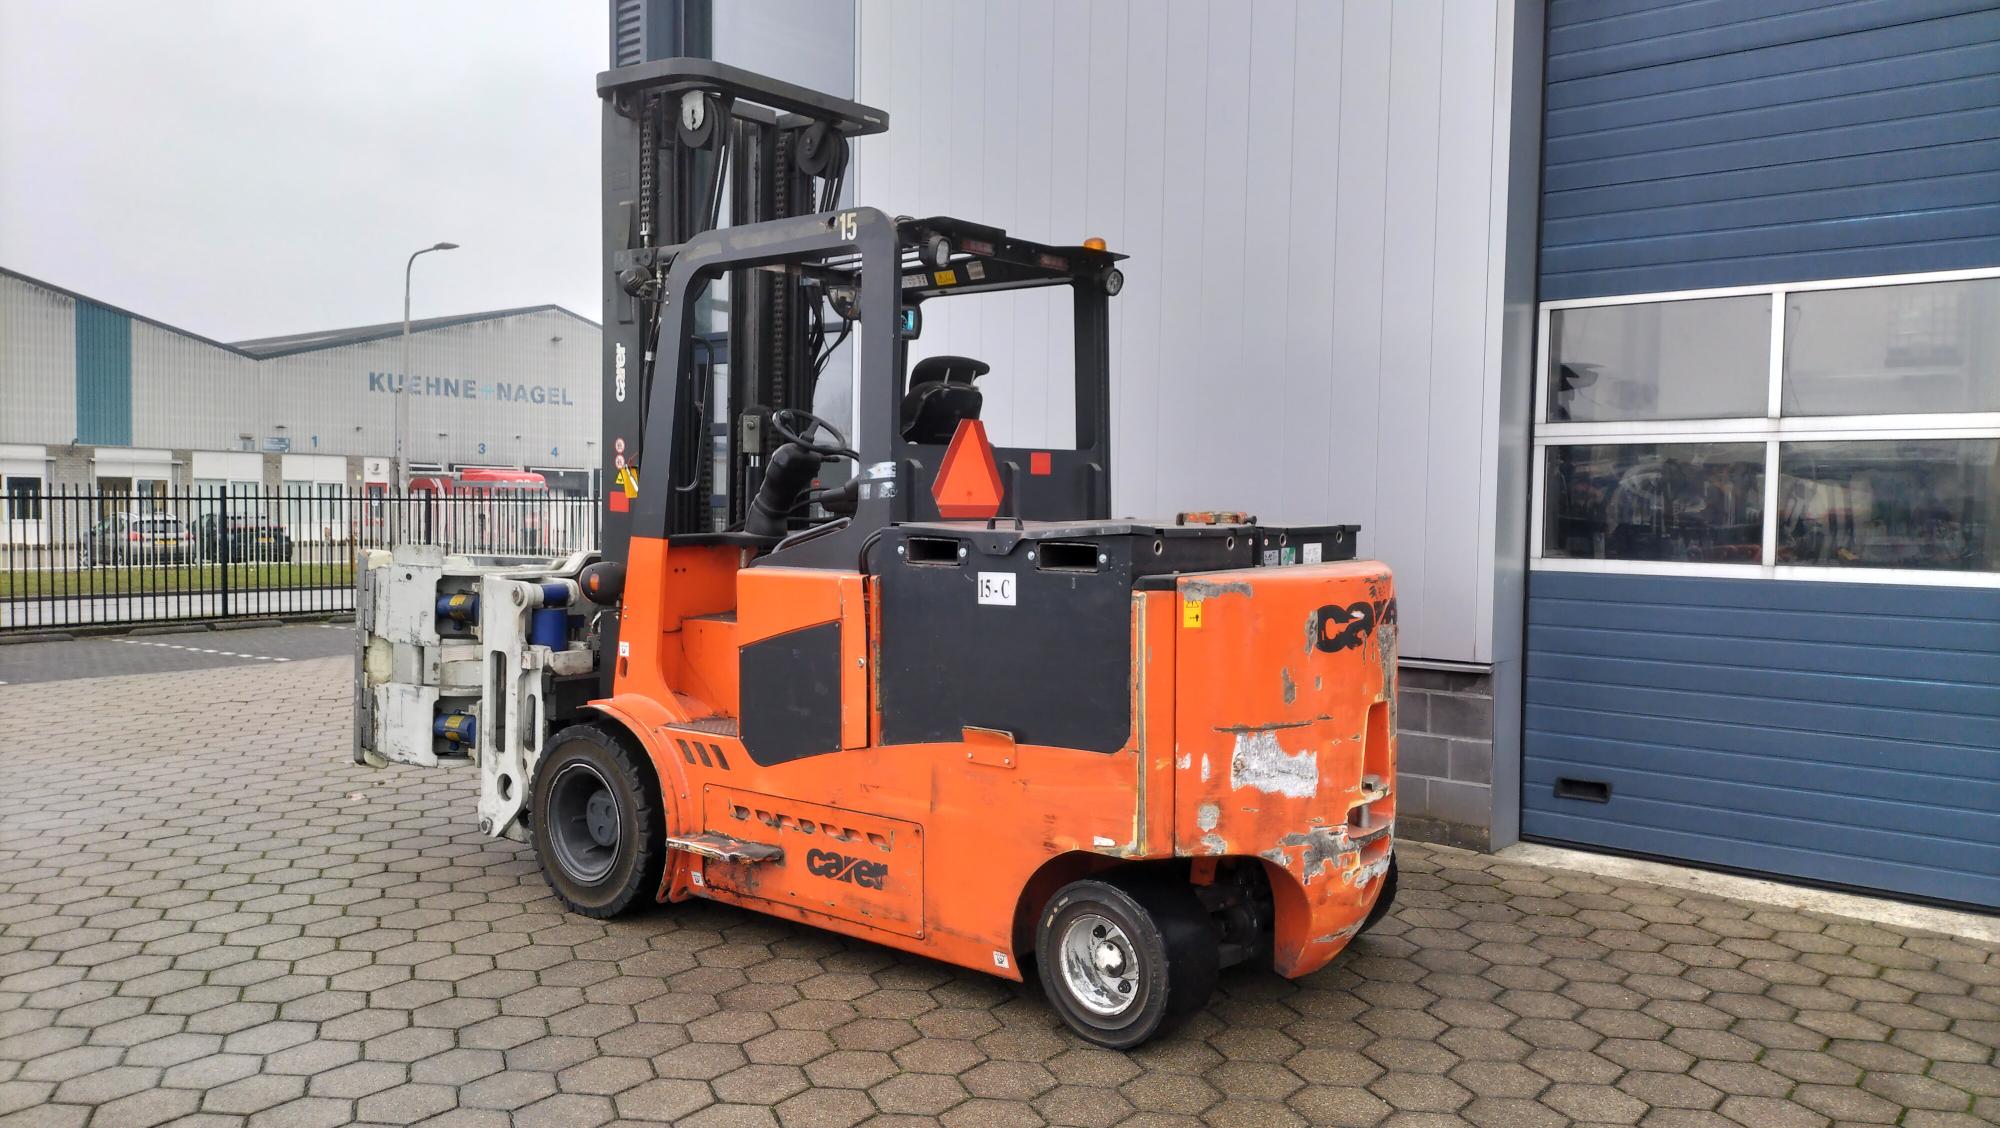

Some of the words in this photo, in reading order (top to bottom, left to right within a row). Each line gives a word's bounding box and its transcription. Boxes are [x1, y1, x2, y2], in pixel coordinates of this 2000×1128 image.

[839, 212, 857, 240] 15
[615, 342, 626, 402] carer
[311, 434, 318, 448] 1
[478, 442, 486, 455] 3
[550, 446, 559, 458] 4
[980, 579, 991, 598] 15
[1001, 579, 1010, 599] C
[806, 848, 889, 891] carer
